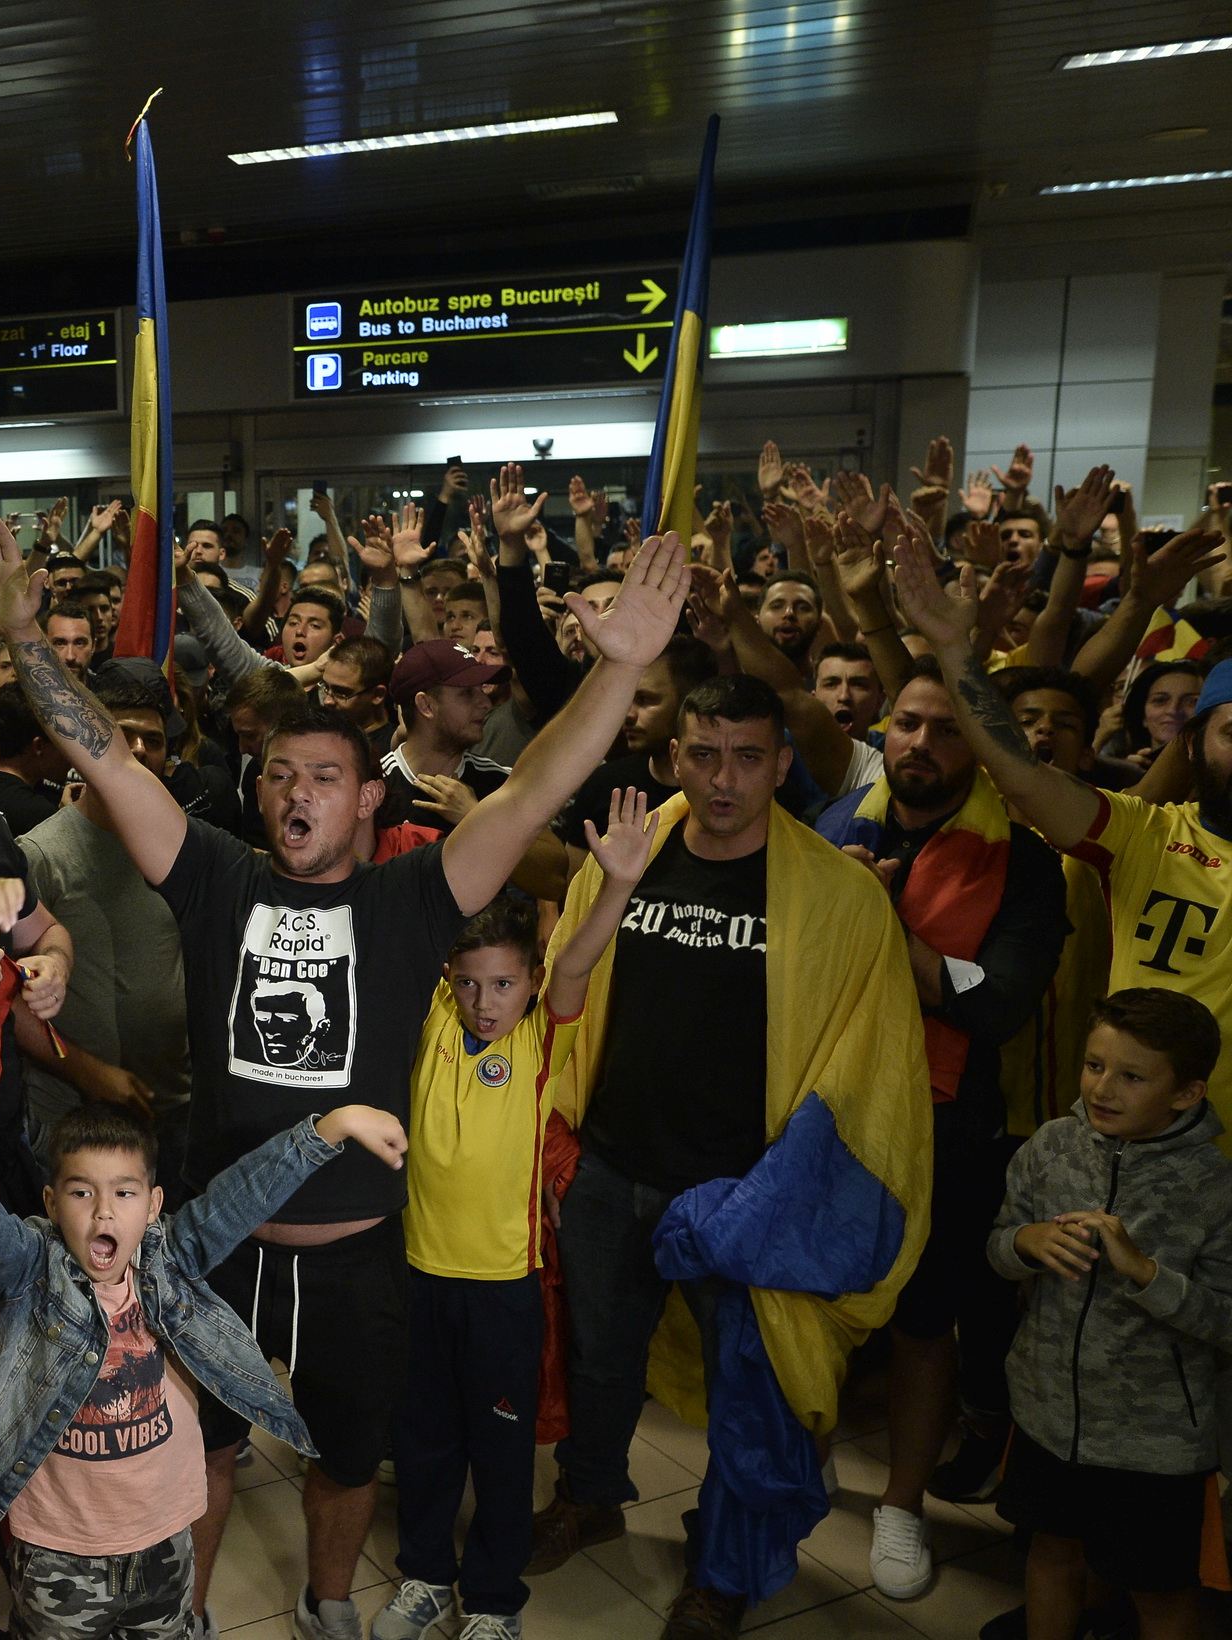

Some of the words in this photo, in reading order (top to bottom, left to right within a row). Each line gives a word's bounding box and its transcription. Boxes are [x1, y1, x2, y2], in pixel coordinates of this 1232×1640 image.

[358, 299, 440, 317] Autobuz
[448, 291, 492, 313] spre
[60, 322, 90, 340] etaj
[98, 320, 106, 336] 1
[359, 321, 391, 338] Bus
[398, 320, 415, 335] to
[422, 312, 508, 333] Bucharest
[51, 343, 88, 358] Floor
[363, 350, 429, 367] Parcare
[362, 370, 419, 389] Parking
[277, 912, 320, 932] A.C.S.
[621, 897, 669, 935] 20
[672, 902, 729, 924] honor
[664, 926, 724, 948] patria
[251, 1067, 275, 1079] made
[276, 1070, 283, 1079] in
[284, 1071, 324, 1083] bucharest
[58, 1426, 111, 1456] COOL
[115, 1410, 169, 1452] VIBES
